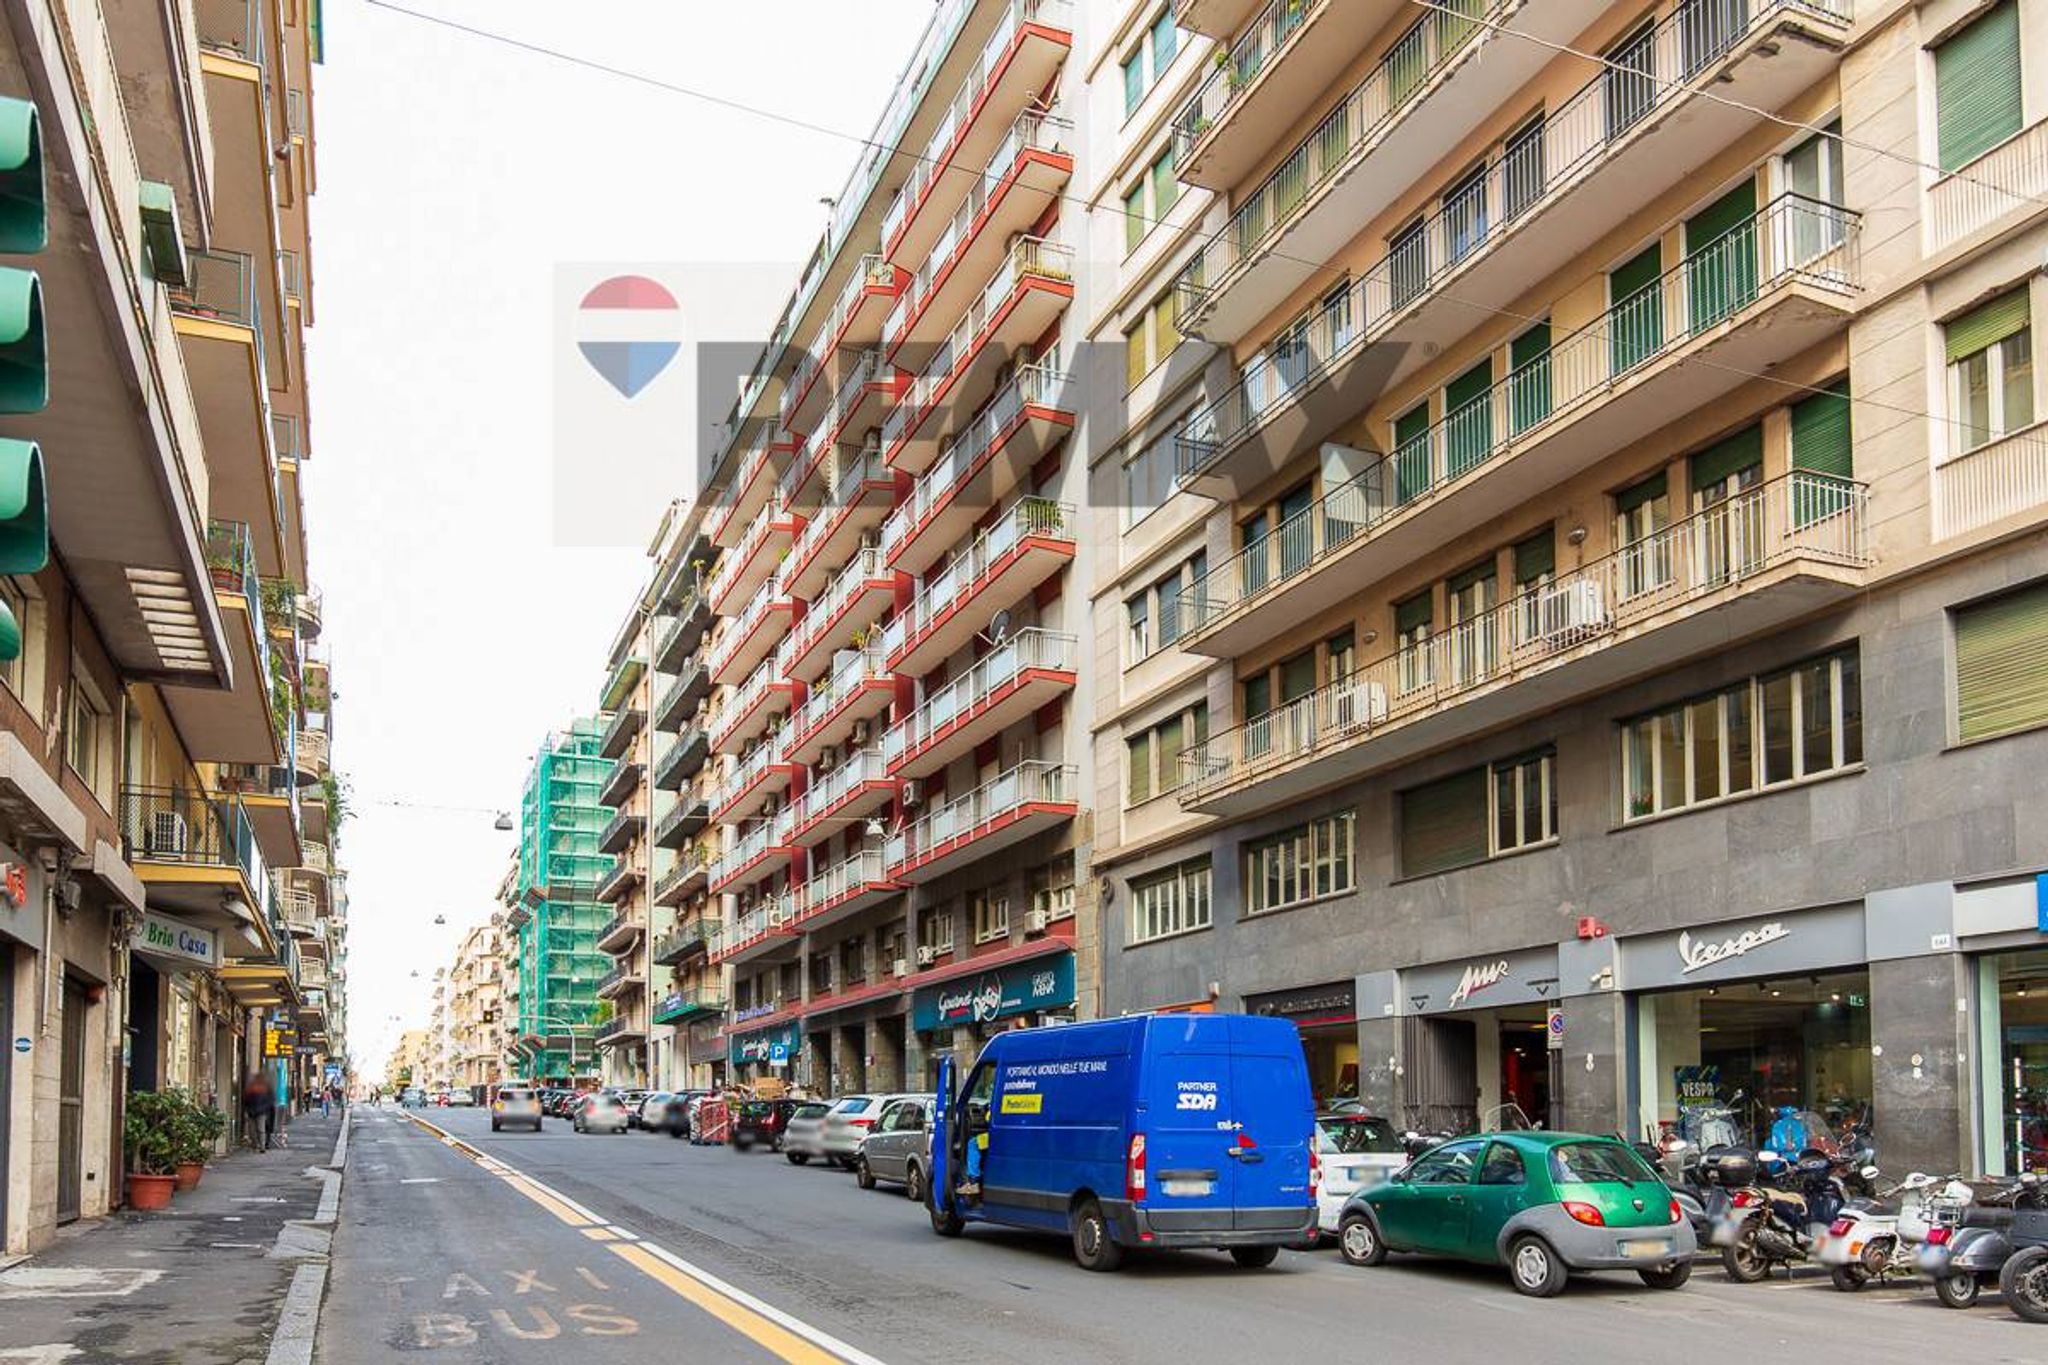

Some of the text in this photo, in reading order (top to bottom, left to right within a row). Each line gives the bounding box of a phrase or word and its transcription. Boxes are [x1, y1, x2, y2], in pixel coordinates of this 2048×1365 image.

[148, 922, 207, 955] Brio Casa
[1679, 923, 1790, 974] Vespa
[1176, 1093, 1217, 1110] SDA
[1177, 1082, 1217, 1091] PARTNER
[1681, 1081, 1715, 1097] VESPA
[368, 1266, 610, 1312] TAXI
[411, 1303, 640, 1349] BUS
